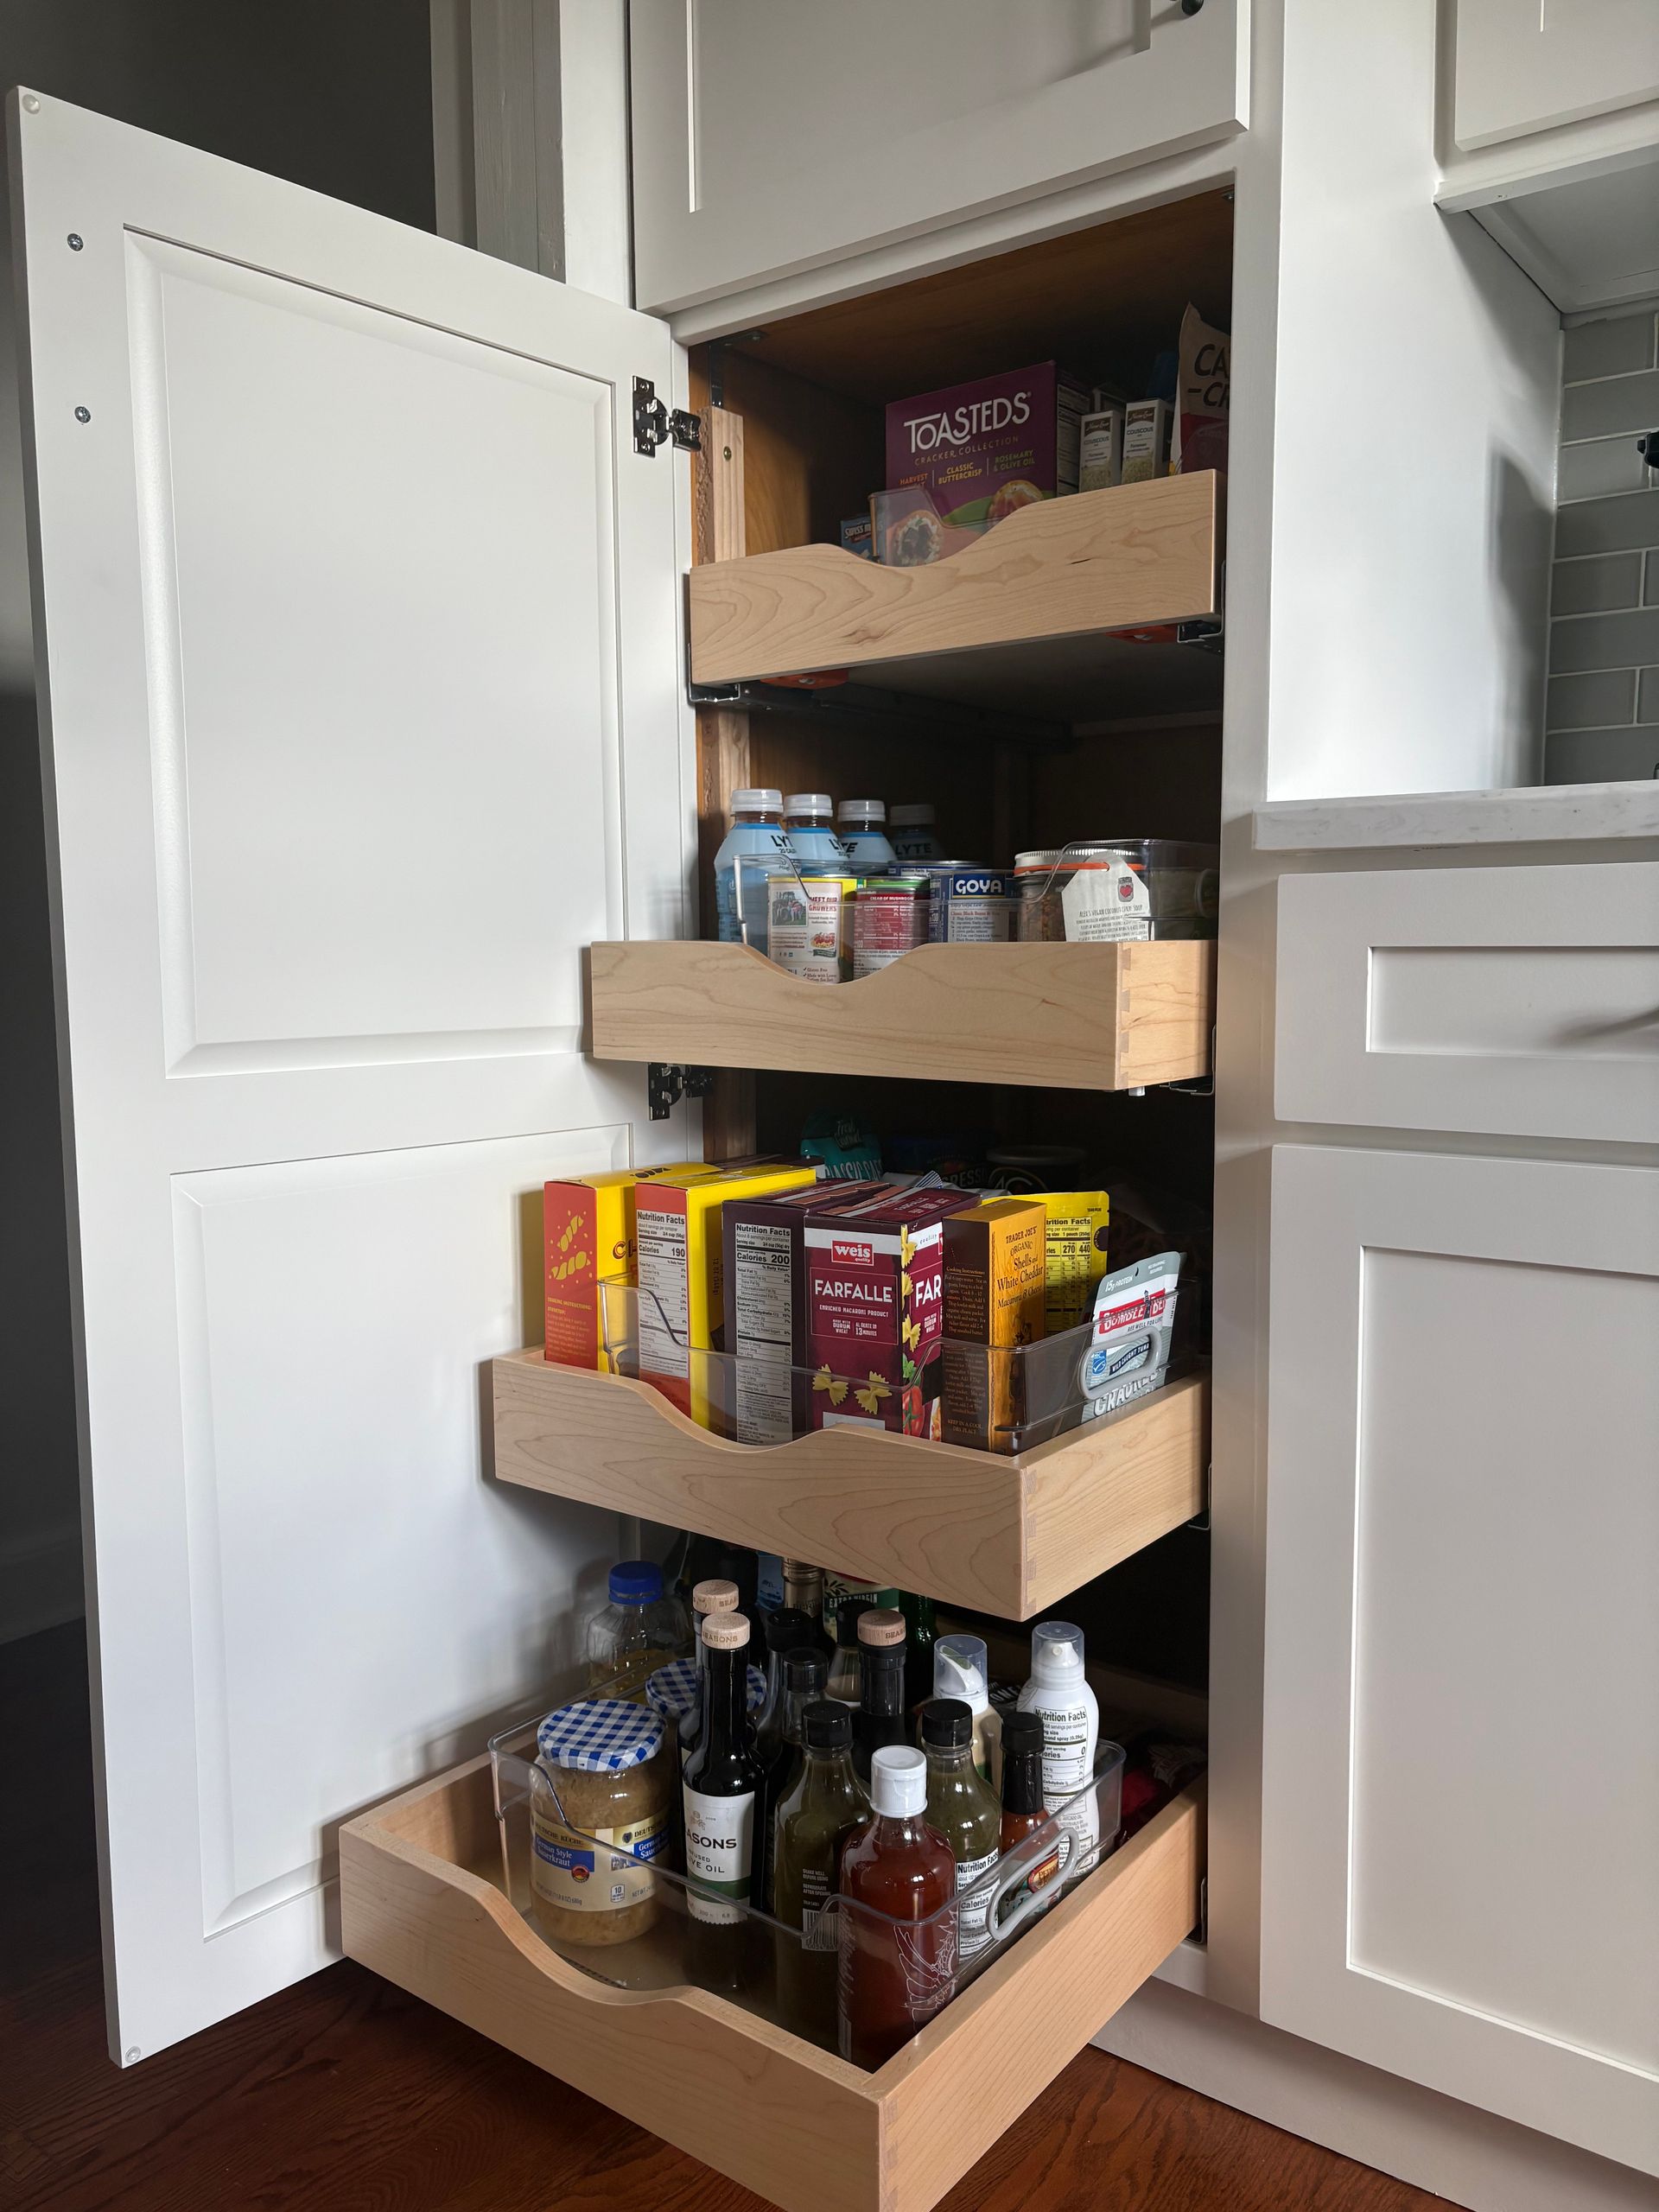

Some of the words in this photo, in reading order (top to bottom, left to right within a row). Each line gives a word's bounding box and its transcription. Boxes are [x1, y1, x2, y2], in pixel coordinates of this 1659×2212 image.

[1194, 344, 1230, 378] CA
[903, 391, 1031, 454] TOASTEDS
[1126, 426, 1154, 435] COUSCOUS
[914, 452, 957, 467] CRACKER
[958, 436, 1019, 456] COLLECTION
[995, 449, 1034, 464] ROSEMARY
[946, 461, 974, 474] CLASSIC
[1000, 460, 1021, 471] OLIVE
[1022, 457, 1035, 467] OIL
[899, 473, 928, 485] HARVEST
[938, 468, 982, 485] BUTTERCRISP
[895, 842, 932, 855] LYTE
[955, 880, 1002, 894] GOYA
[808, 904, 837, 912] GROWERS
[637, 1211, 664, 1223] Nutrition
[665, 1215, 685, 1225] Facts
[736, 1224, 767, 1234] Nutrition
[769, 1228, 791, 1236] Facts
[1005, 1230, 1024, 1244] TRADER
[1024, 1225, 1038, 1237] JOE'S
[639, 1244, 660, 1254] Calories
[671, 1247, 685, 1257] 190
[834, 1244, 871, 1258] weis
[1010, 1241, 1033, 1256] ORGANIC
[1063, 1244, 1076, 1254] 270
[1078, 1244, 1090, 1254] 440
[736, 1252, 767, 1262] Calories
[771, 1254, 790, 1265] 200
[1014, 1253, 1032, 1271] Shells
[997, 1275, 1019, 1292] White
[1020, 1264, 1044, 1283] Cheddar
[1105, 1280, 1115, 1293] 15g
[1115, 1275, 1134, 1288] PROTEIN
[815, 1279, 893, 1303] FARFALLE
[915, 1274, 942, 1308] FAR
[998, 1294, 1022, 1309] Macaroni
[1022, 1288, 1028, 1300] &
[924, 1318, 937, 1329] DURUM
[926, 1325, 935, 1334] WHEAT
[1135, 1321, 1146, 1330] WELL
[1111, 1361, 1122, 1373] WILD
[1121, 1349, 1137, 1363] CAUGHT
[1137, 1342, 1150, 1354] TUNA
[702, 1630, 738, 1643] SEASONS
[1068, 1710, 1086, 1722] Facts
[1081, 1746, 1086, 1755] 0
[634, 1825, 656, 1838] DEUTS
[687, 1827, 737, 1849] ASONS
[537, 1838, 555, 1854] German
[556, 1847, 573, 1859] Style
[639, 1838, 658, 1852] Germ
[537, 1845, 571, 1867] Sauerkraut
[957, 1860, 987, 1874] Nutrition
[987, 1851, 999, 1867] Facts
[705, 1865, 725, 1873] OIL
[960, 1897, 989, 1910] Calories
